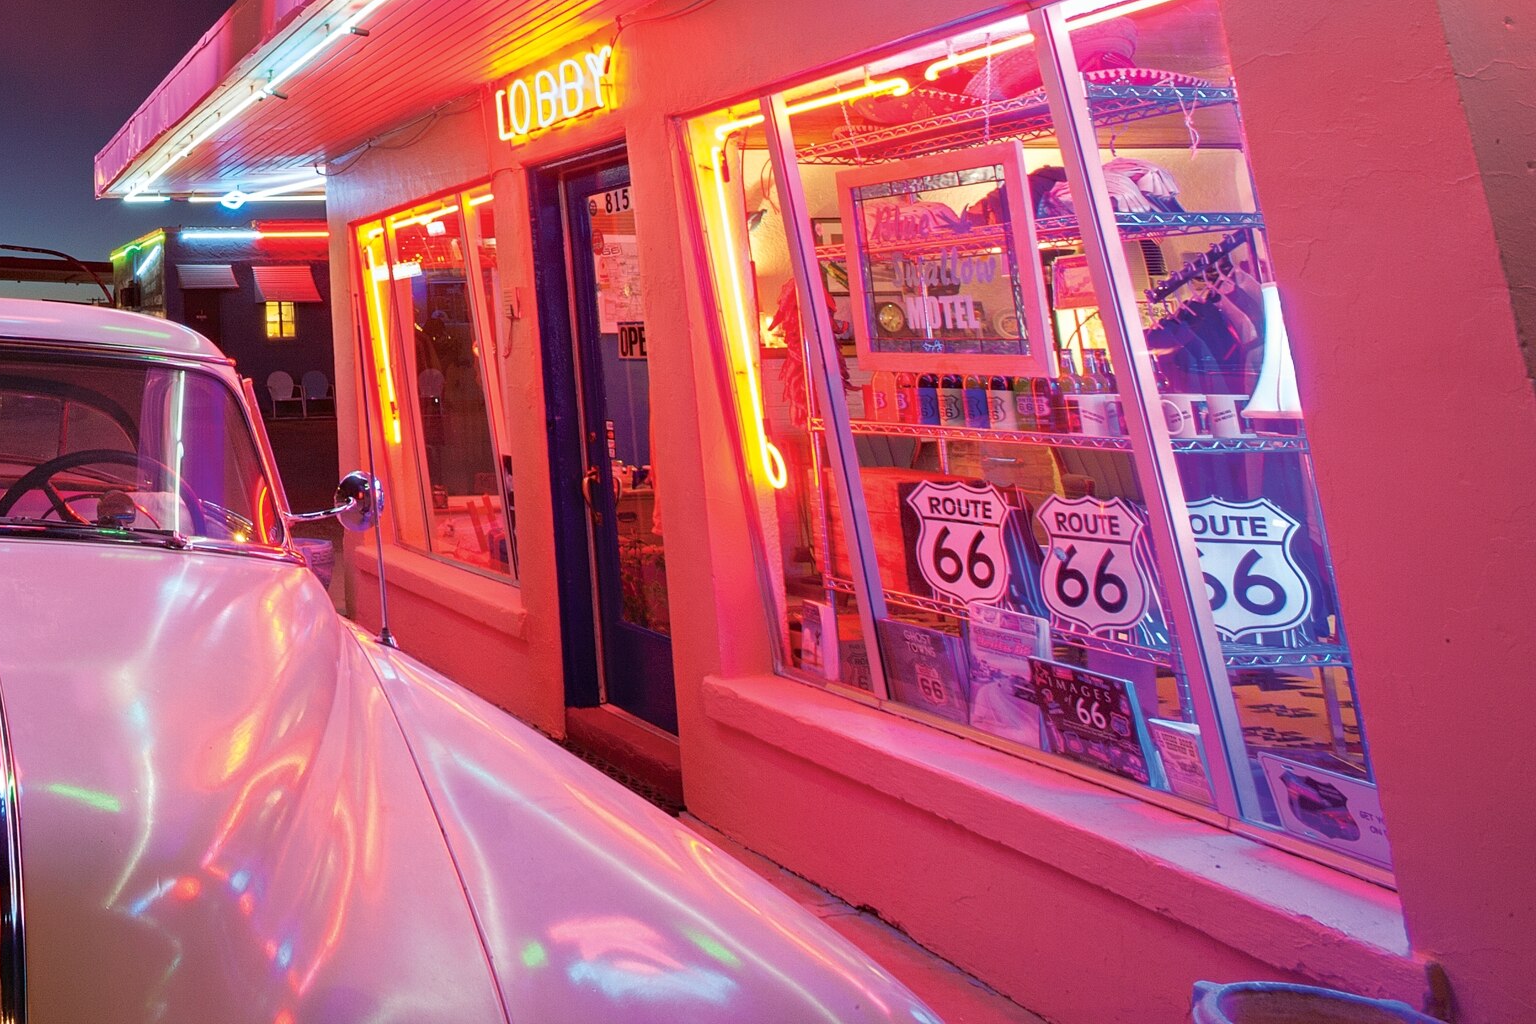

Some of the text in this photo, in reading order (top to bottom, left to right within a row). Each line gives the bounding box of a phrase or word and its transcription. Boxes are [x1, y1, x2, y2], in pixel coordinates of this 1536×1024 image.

[495, 45, 612, 141] LOBBY
[605, 188, 630, 213] 815
[892, 246, 996, 289] Swallow
[905, 294, 981, 330] MOTEL
[928, 496, 993, 519] ROUTE
[1054, 511, 1121, 536] ROUTE
[1189, 514, 1269, 537] OUTE
[933, 526, 995, 589] 66
[1056, 544, 1128, 614] 66
[903, 629, 932, 645] GHOST
[905, 640, 937, 657] TOWNS
[920, 677, 945, 701] 66
[1048, 676, 1112, 703] IMAGES
[1076, 697, 1108, 730] 66
